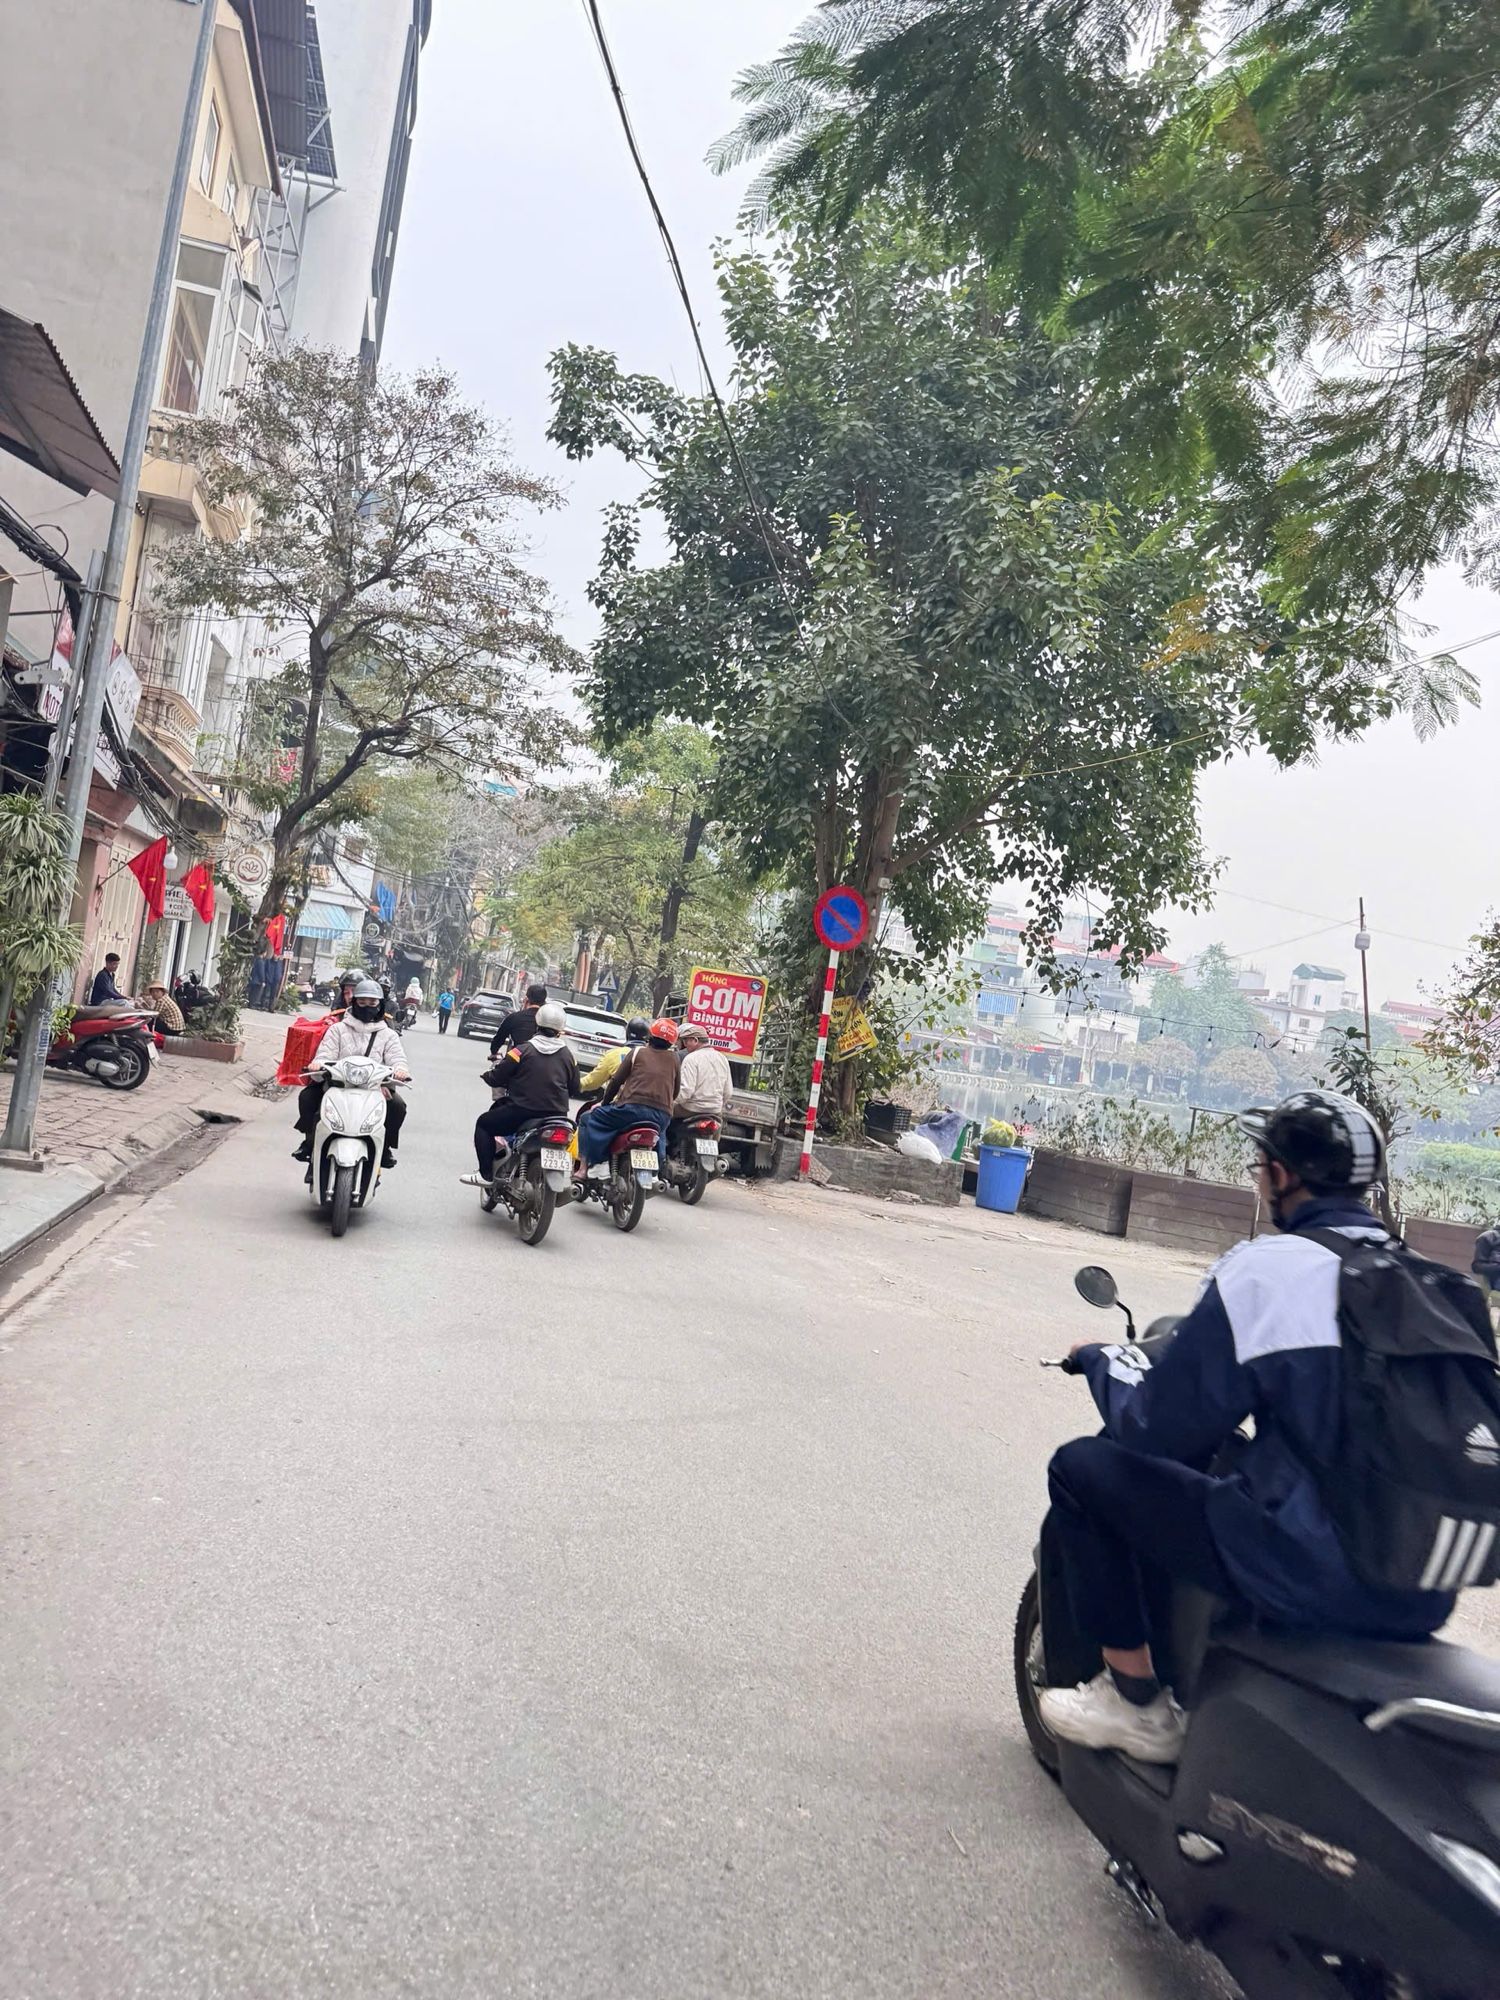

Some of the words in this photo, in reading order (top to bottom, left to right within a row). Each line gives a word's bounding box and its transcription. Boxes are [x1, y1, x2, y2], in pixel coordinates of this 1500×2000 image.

[691, 984, 763, 1019] CƠM
[692, 1011, 724, 1026] BÌNH
[727, 1018, 754, 1031] DÂN
[705, 1025, 738, 1039] 30K
[709, 1039, 730, 1048] 100M
